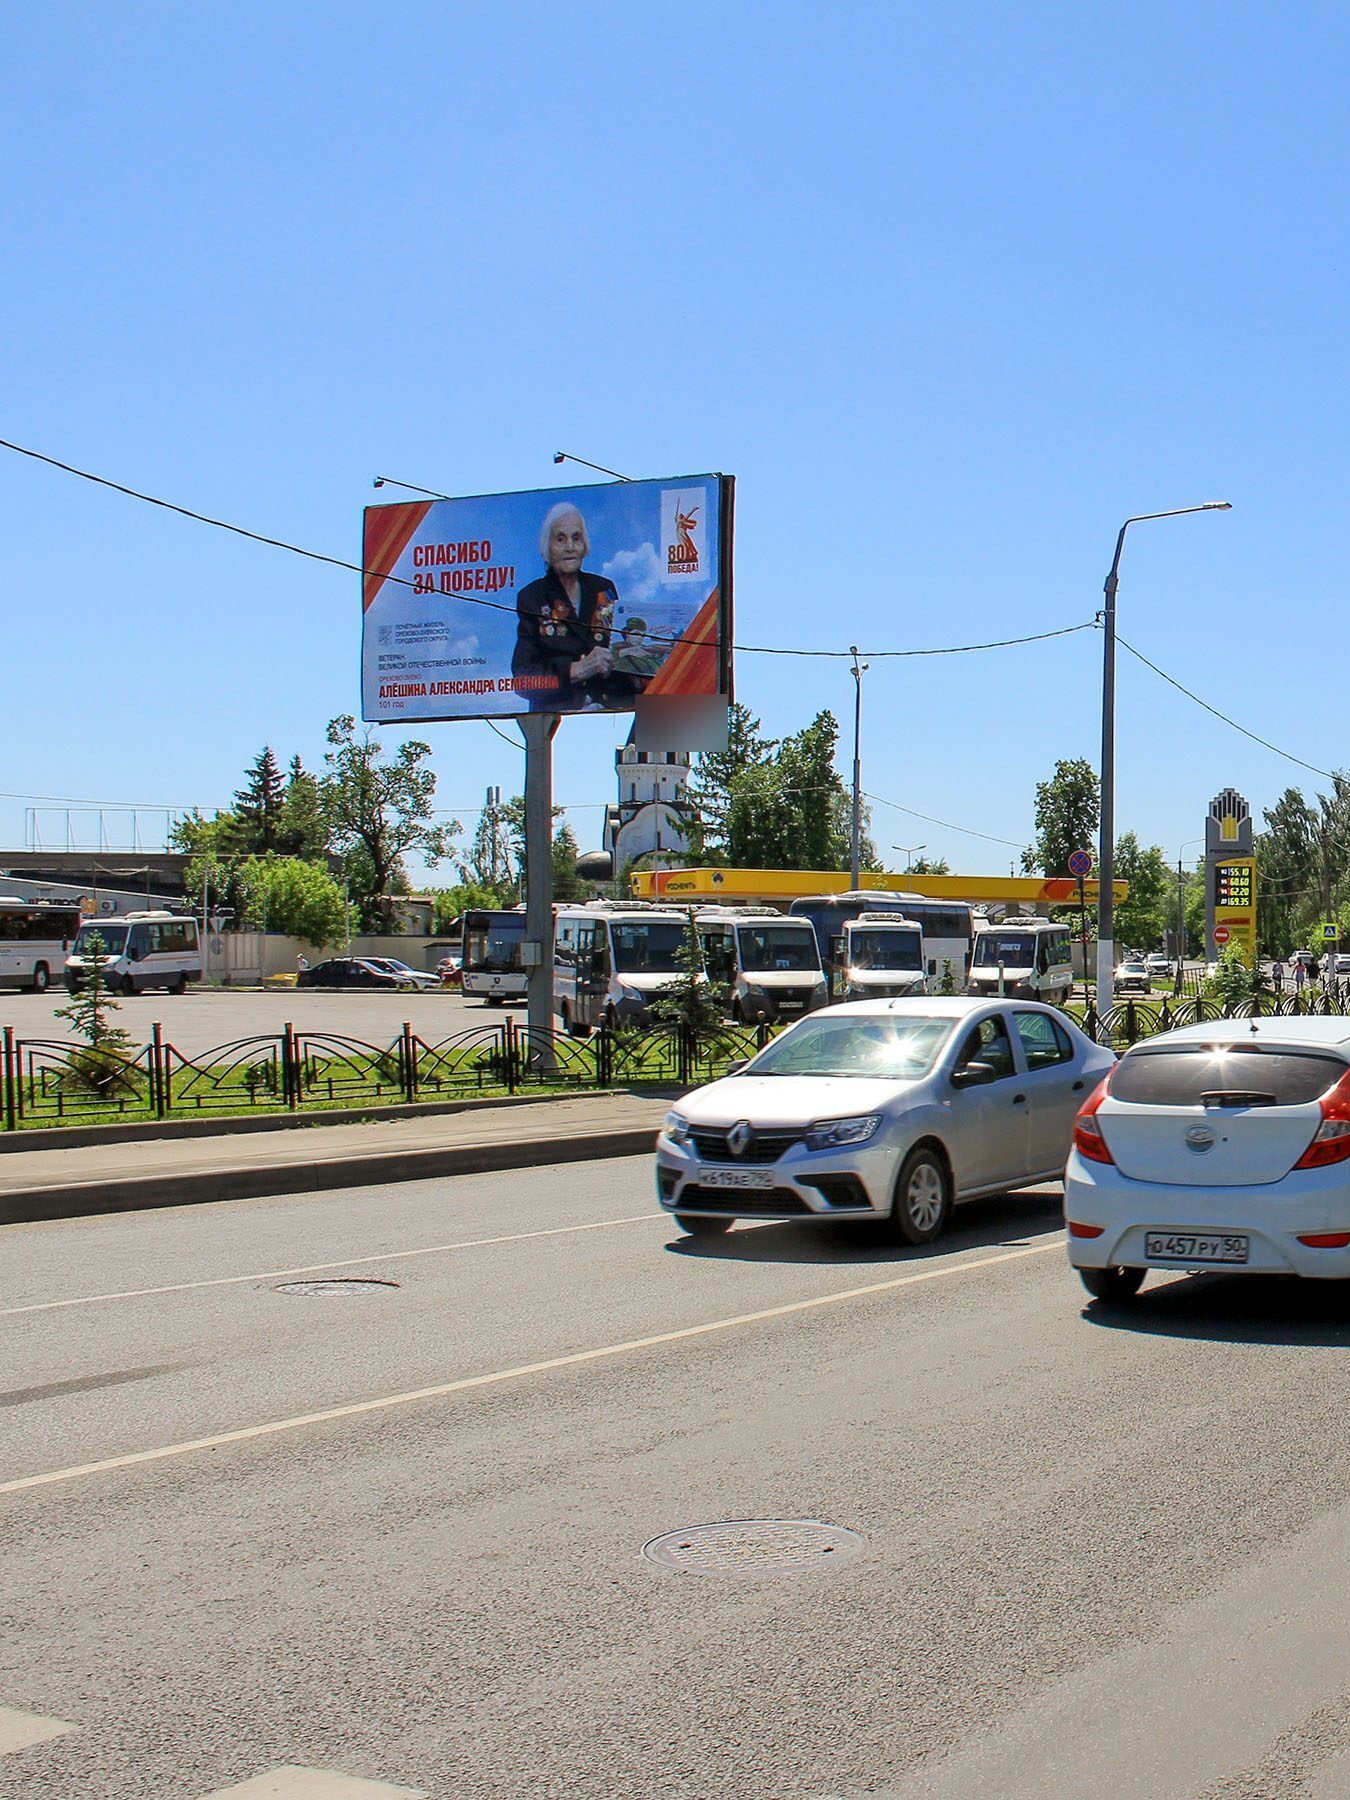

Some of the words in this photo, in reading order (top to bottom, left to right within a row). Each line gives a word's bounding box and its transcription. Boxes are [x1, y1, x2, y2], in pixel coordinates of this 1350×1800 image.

[413, 540, 491, 567] СПАСИБО
[668, 544, 685, 561] 80
[667, 563, 699, 574] ПОБЕДА!
[413, 572, 435, 594] ЗА
[440, 566, 515, 592] ПОБЕДУ!
[379, 683, 427, 698] АЛЁШИНА
[429, 680, 495, 695] АЛЕКСАНДРА
